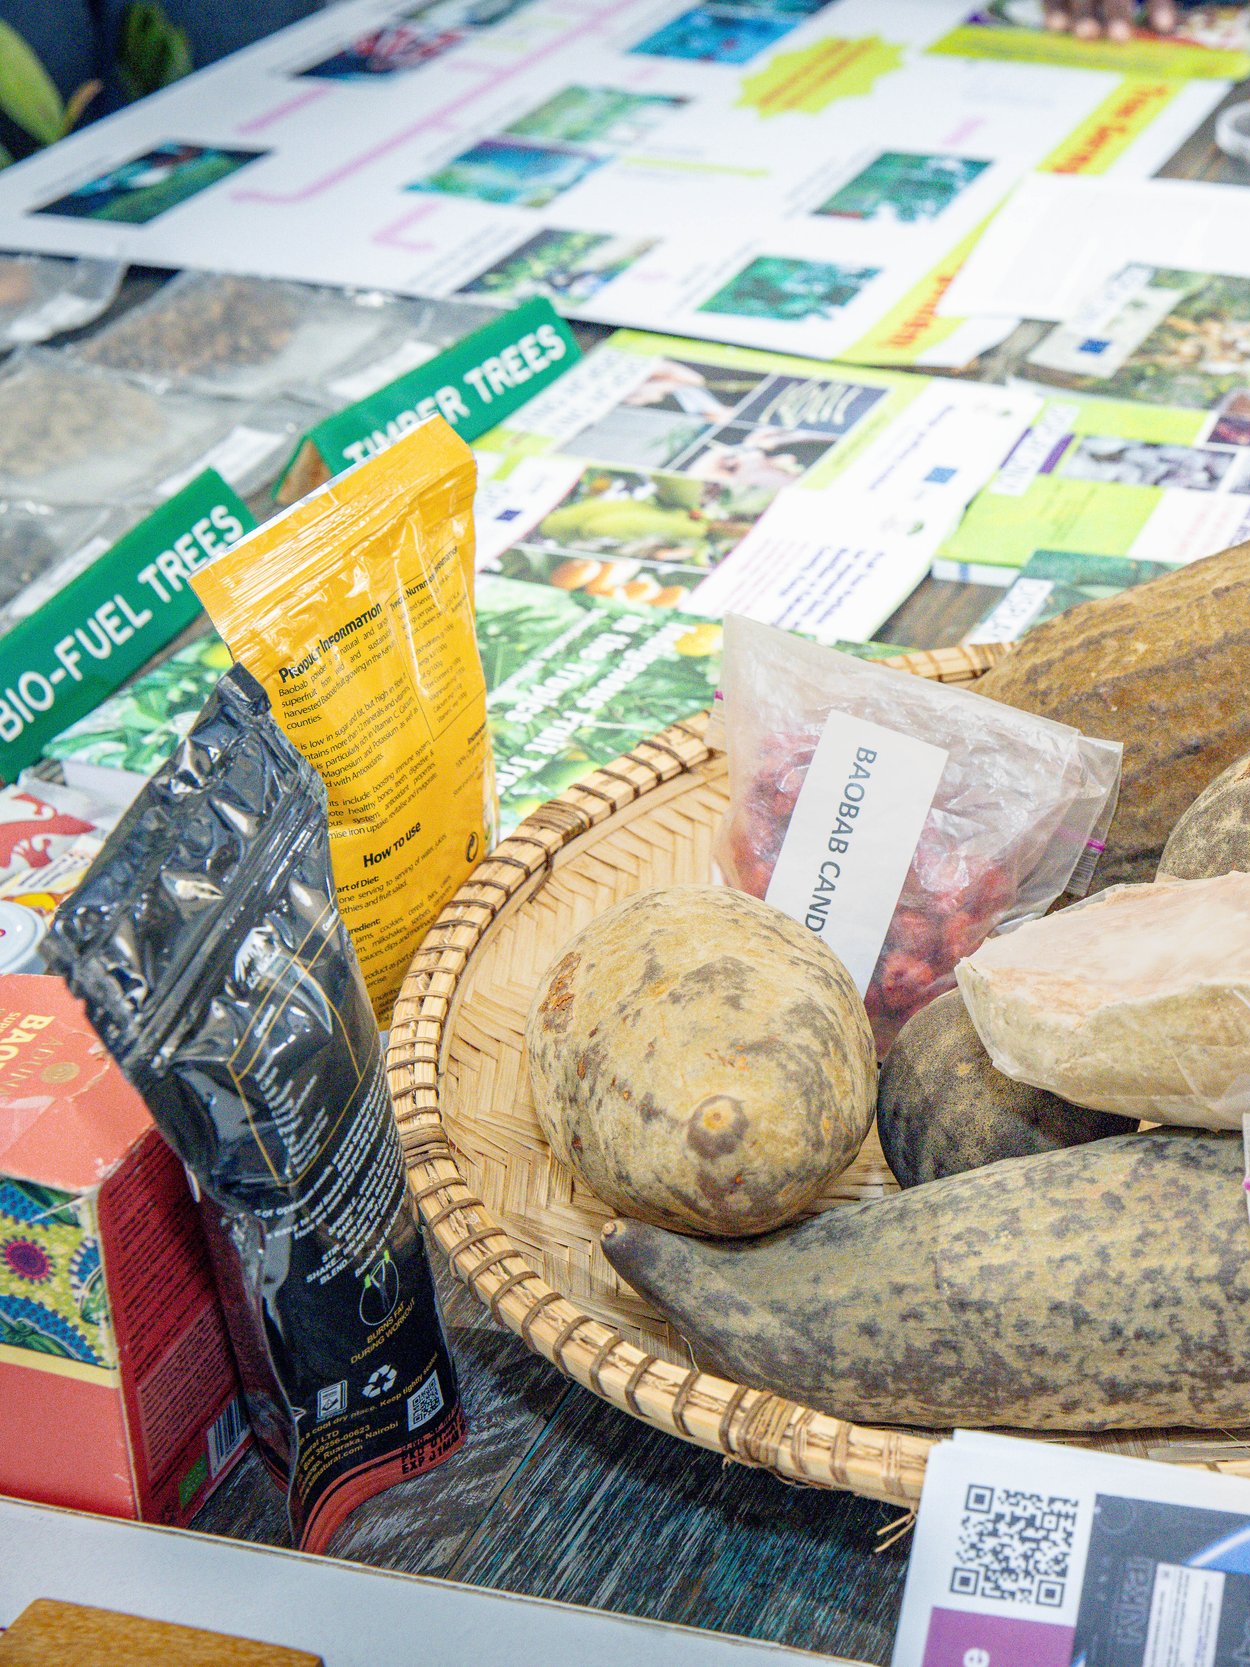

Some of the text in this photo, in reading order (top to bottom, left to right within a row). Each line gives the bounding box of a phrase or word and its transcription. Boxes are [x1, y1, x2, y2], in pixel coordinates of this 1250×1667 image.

[463, 324, 567, 404] TREES
[137, 504, 245, 604] TREES
[279, 680, 309, 697] Baobab
[340, 637, 360, 655] natural
[363, 627, 375, 640] and
[281, 688, 318, 708] superfruit
[350, 651, 362, 662] and
[284, 698, 322, 719] harvested
[504, 662, 599, 724] Tropics
[286, 715, 322, 730] counties.
[300, 741, 308, 750] is
[309, 737, 325, 748] low
[326, 732, 334, 742] in
[335, 722, 349, 740] sugar
[365, 700, 376, 713] but
[375, 690, 389, 703] high
[330, 739, 348, 754] more
[363, 709, 385, 727] minerals
[525, 710, 596, 755] Fruit
[321, 755, 364, 779] Magnesium
[363, 746, 373, 758] and
[373, 725, 400, 750] Potassium
[325, 743, 362, 769] particularly
[359, 735, 368, 748] rich
[368, 730, 375, 738] in
[373, 716, 394, 735] Vitamin
[333, 775, 352, 788] with
[372, 772, 395, 793] boosting
[348, 800, 376, 815] healthy
[349, 826, 366, 836] iron
[804, 746, 878, 937] BAOBAB CAND
[339, 895, 355, 903] one
[358, 885, 384, 900] serving
[386, 879, 393, 888] to
[395, 862, 414, 883] serving
[414, 856, 421, 866] of
[363, 847, 392, 868] How
[336, 875, 380, 893] art of Diet:
[339, 903, 364, 915] othies
[364, 897, 380, 908] and
[379, 889, 391, 901] fruit
[364, 966, 391, 979] roduct
[351, 1297, 415, 1364] DURING WORKOUT
[367, 1301, 405, 1344] BURNS FAT
[311, 1422, 332, 1434] cool
[334, 1415, 348, 1426] dry
[380, 1393, 402, 1407] Keep
[403, 1374, 423, 1394] tightly
[315, 1424, 371, 1458] 39256-00623
[321, 1430, 339, 1442] LTD
[365, 1421, 398, 1440] Nairobi
